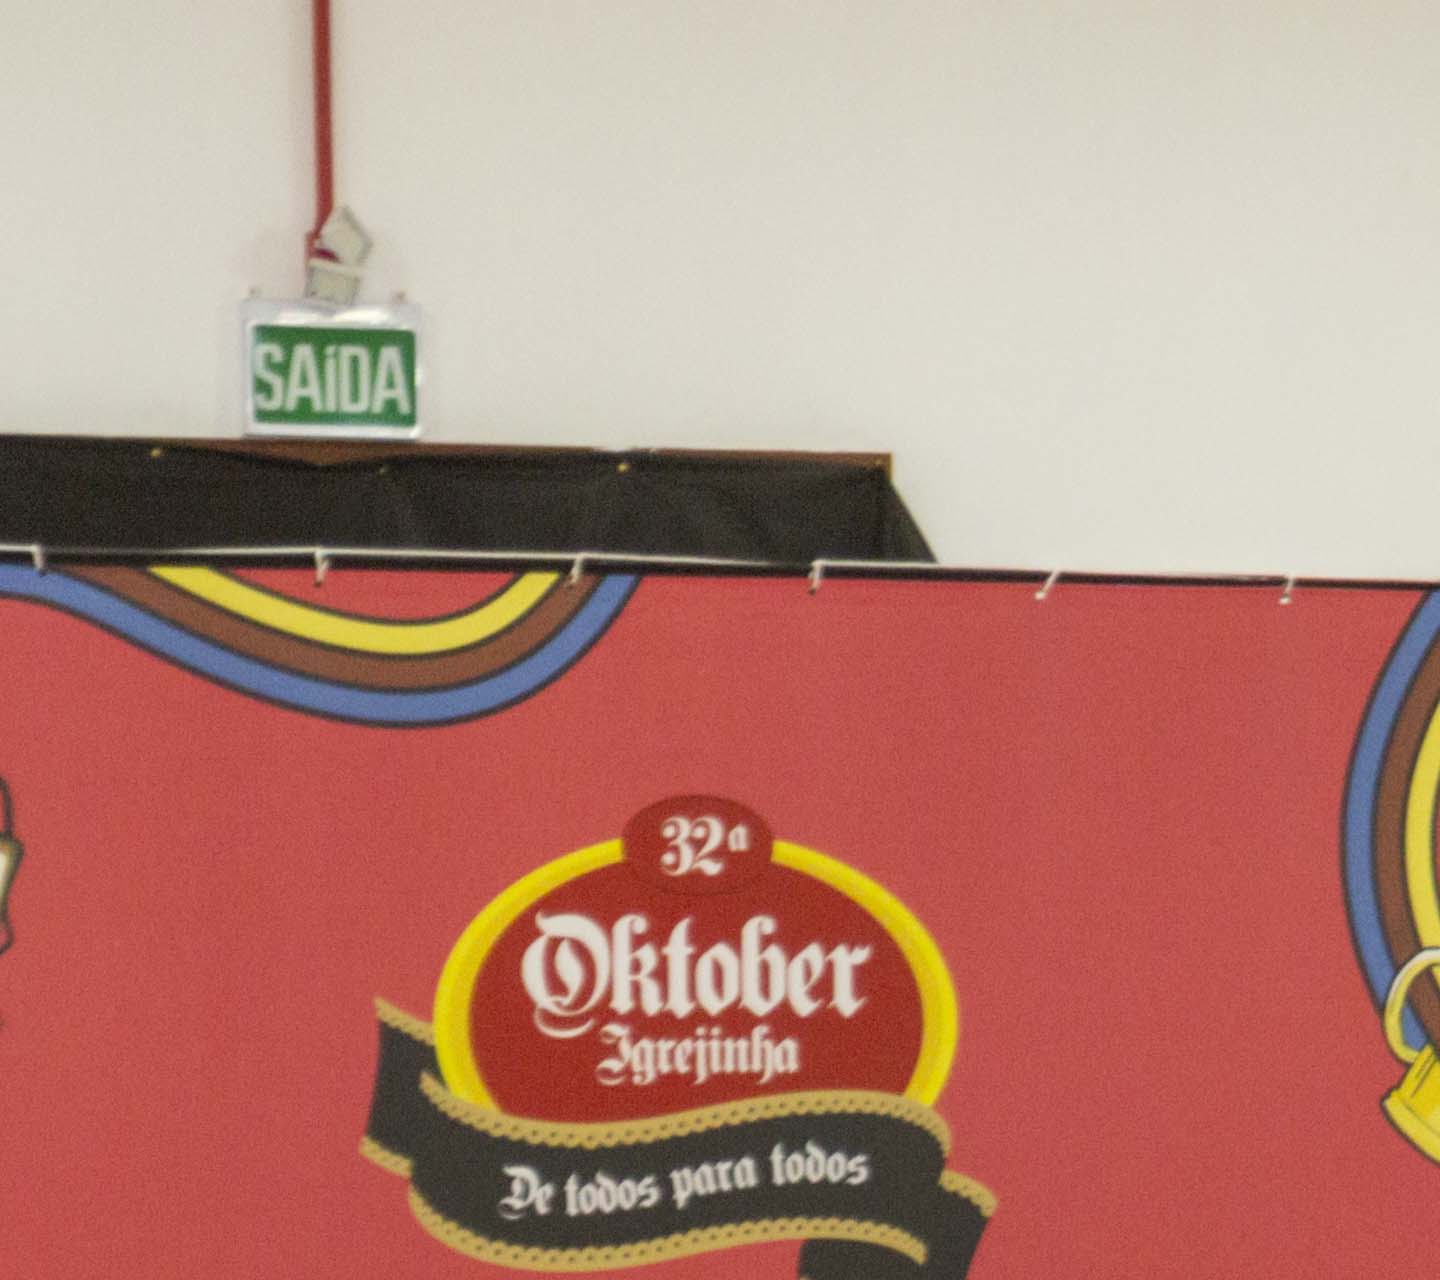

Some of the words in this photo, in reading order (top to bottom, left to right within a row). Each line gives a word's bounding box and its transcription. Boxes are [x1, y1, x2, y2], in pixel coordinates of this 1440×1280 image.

[521, 911, 873, 1038] Oktober
[596, 1025, 800, 1087] Igrejinha
[499, 1164, 555, 1221] De
[563, 1161, 662, 1217] todos
[669, 1157, 758, 1211] para
[769, 1141, 870, 1188] todos
